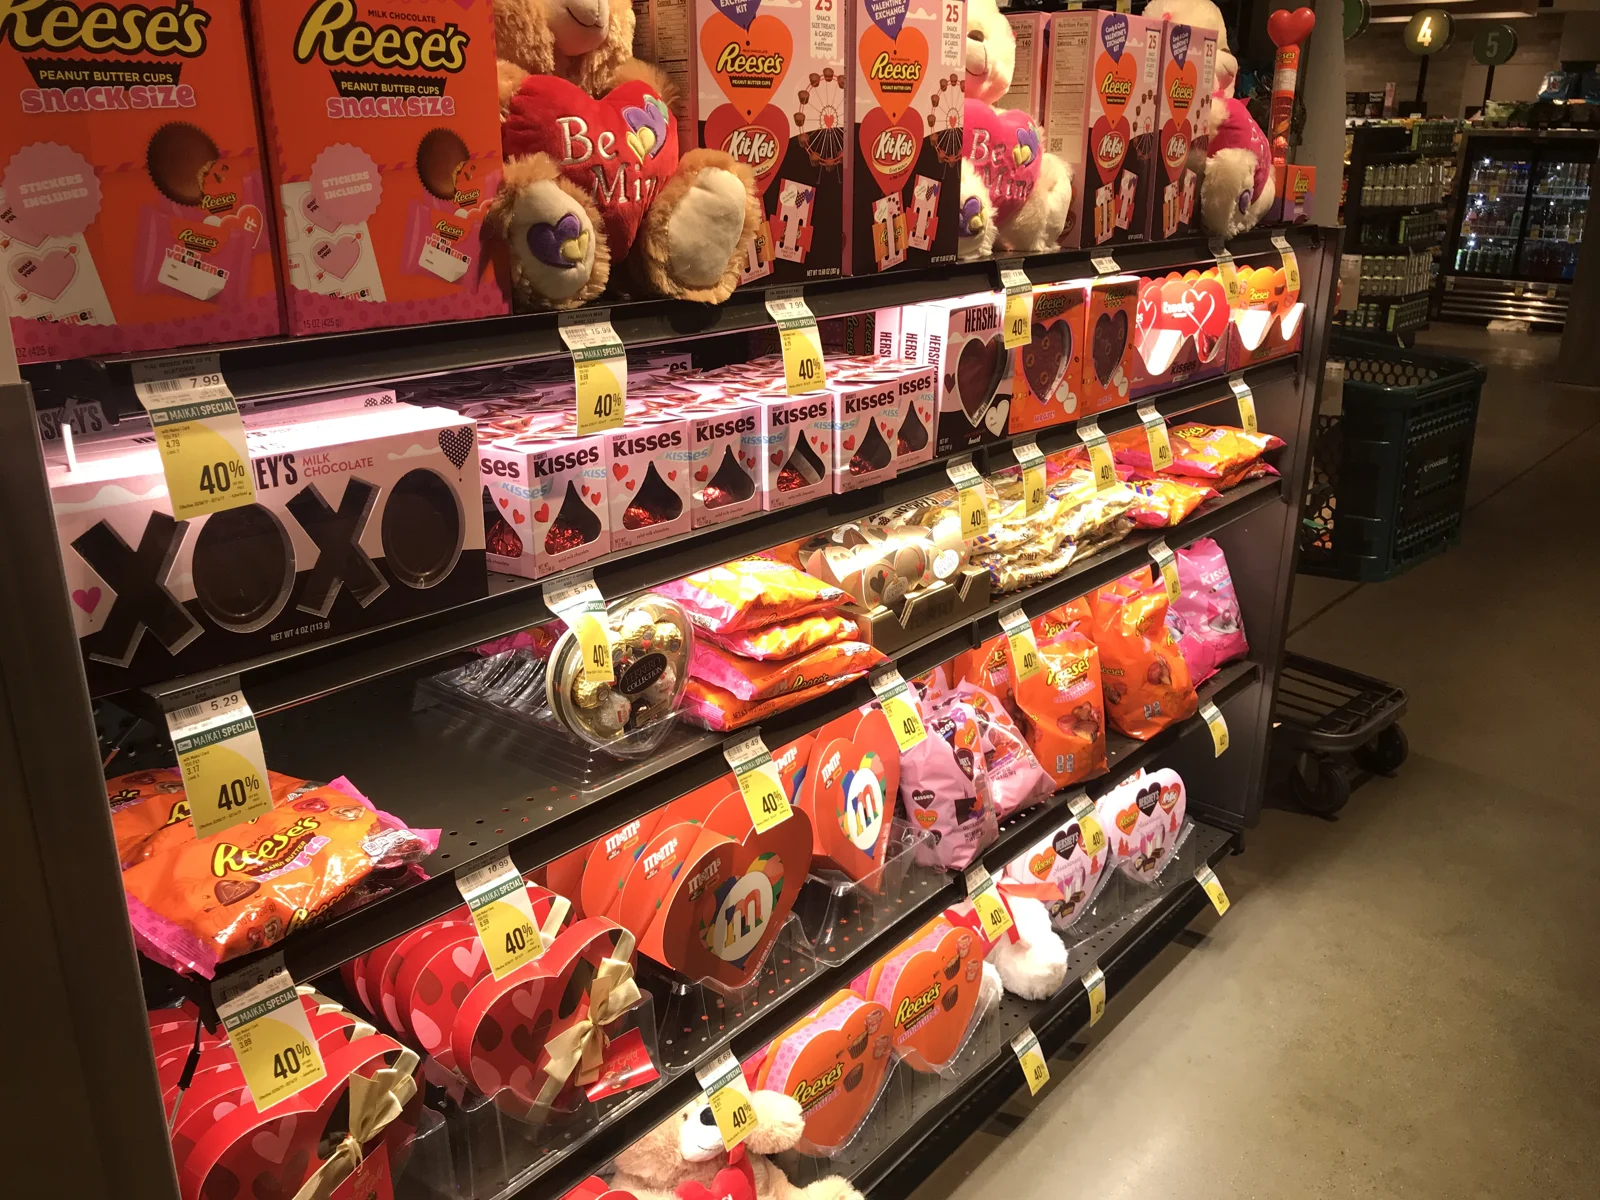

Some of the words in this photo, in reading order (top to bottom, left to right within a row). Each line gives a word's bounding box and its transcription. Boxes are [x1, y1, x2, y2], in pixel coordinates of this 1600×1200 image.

[367, 9, 388, 19] MILK
[389, 11, 436, 23] CHOCOLATE
[736, 4, 748, 14] KIT
[875, 5, 906, 20] EXCHANGE
[946, 4, 959, 23] 25
[887, 17, 896, 26] KIT
[298, 0, 467, 69] Reese's
[1416, 16, 1433, 47] 4
[1148, 35, 1156, 49] 25
[1206, 44, 1213, 57] 25
[1486, 32, 1500, 58] 5
[716, 43, 784, 74] Reese's
[870, 53, 922, 80] Reese's
[39, 70, 90, 81] PEANUT
[93, 71, 140, 82] BUTTER
[143, 73, 173, 83] CUPS
[1101, 73, 1132, 95] Reese's
[341, 81, 379, 92] PEANUT
[381, 83, 415, 94] BUTTER
[417, 85, 440, 95] CUPS
[1170, 80, 1193, 99] Reese's
[556, 116, 617, 165] Be
[970, 128, 1006, 165] Be
[19, 174, 83, 195] STICKERS
[322, 172, 370, 188] STICKERS
[23, 188, 89, 208] INCLUDED
[324, 183, 373, 200] INCLUDED
[454, 190, 480, 203] Reese's
[201, 193, 236, 209] Reese's
[436, 220, 465, 237] Reese's
[179, 229, 218, 248] Reese's
[1034, 293, 1066, 310] Reese's
[303, 320, 311, 329] 15
[312, 319, 320, 328] OZ
[321, 317, 335, 328] (425
[591, 327, 612, 335] 15.99
[799, 318, 816, 327] SPECIAL
[1012, 318, 1028, 336] 40%
[602, 346, 624, 357] SPECIAL
[799, 358, 821, 380] 40%
[190, 375, 220, 388] 7.99
[200, 401, 236, 415] SPECIAL
[594, 393, 622, 418] 40%
[166, 439, 180, 449] 4.79
[1158, 445, 1170, 460] 40%
[303, 453, 330, 467] MILK
[304, 457, 373, 478] CHOCOLATE
[199, 460, 245, 494] 40%
[1101, 464, 1113, 480] 40%
[1032, 488, 1044, 503] 40%
[971, 509, 986, 526] 40%
[573, 583, 594, 594] 5.79
[270, 632, 283, 642] NET
[284, 629, 294, 638] WT
[294, 627, 299, 635] 4
[300, 625, 309, 634] OZ
[310, 622, 323, 633] (113
[593, 645, 610, 668] 40%
[1024, 651, 1037, 669] 40%
[627, 666, 663, 692] COLLECTION
[211, 694, 239, 711] 5.29
[222, 720, 255, 738] SPECIAL
[903, 715, 919, 736] 40%
[745, 738, 759, 750] 6.49
[756, 753, 772, 766] SPECIAL
[186, 765, 200, 775] 3.17
[218, 774, 260, 811] 40%
[1138, 790, 1160, 808] HERSHEY'S
[762, 790, 783, 814] 40%
[852, 783, 879, 837] m
[1120, 811, 1138, 826] Reese's
[213, 817, 318, 877] Reese's
[1055, 832, 1079, 851] HERSHEY'S
[260, 861, 285, 873] PEANUT
[285, 840, 306, 863] BUTTER
[1033, 855, 1055, 872] Reese's
[487, 859, 509, 874] 10.99
[499, 879, 523, 894] SPECIAL
[725, 888, 762, 948] m
[990, 906, 1005, 926] 40%
[505, 923, 534, 955] 40%
[256, 966, 282, 984] 6.49
[266, 991, 298, 1011] SPECIAL
[895, 982, 941, 1028] Reese's
[239, 1038, 252, 1049] 3.89
[273, 1041, 311, 1080] 40%
[717, 1051, 731, 1065] 6.69
[725, 1067, 741, 1082] SPECIAL
[1033, 1062, 1045, 1081] 40%
[791, 1062, 844, 1104] Reese's
[732, 1101, 752, 1128] 40%
